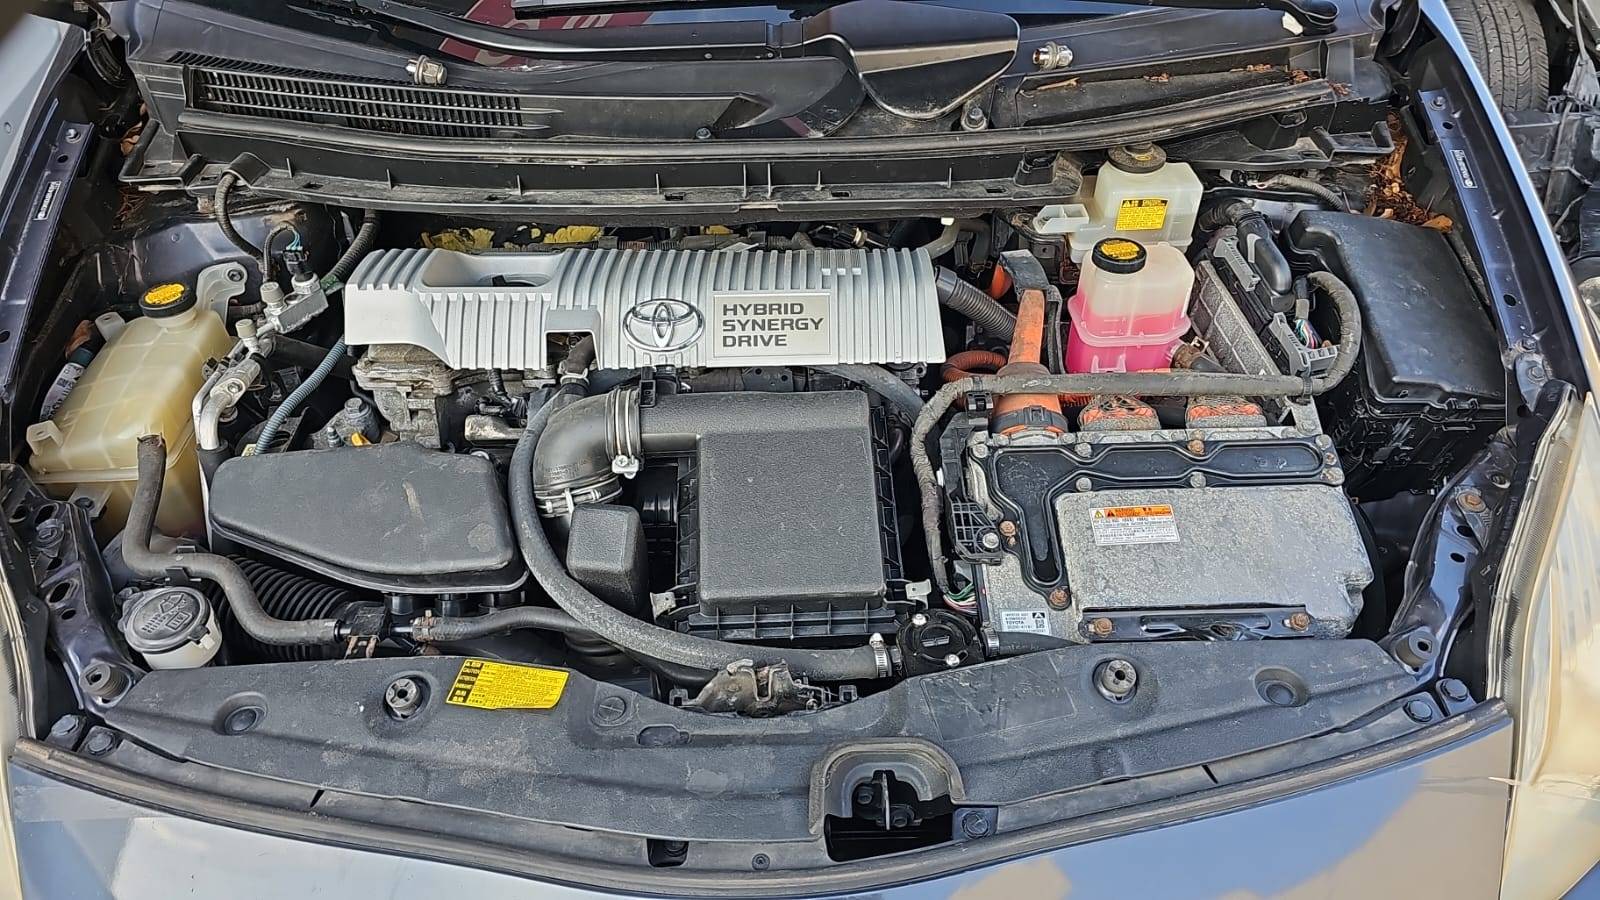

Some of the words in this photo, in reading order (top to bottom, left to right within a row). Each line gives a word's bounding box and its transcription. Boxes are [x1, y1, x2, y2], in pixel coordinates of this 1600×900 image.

[723, 303, 804, 315] HYBRID
[723, 318, 824, 331] SYNERGY
[723, 334, 787, 347] DRIVE
